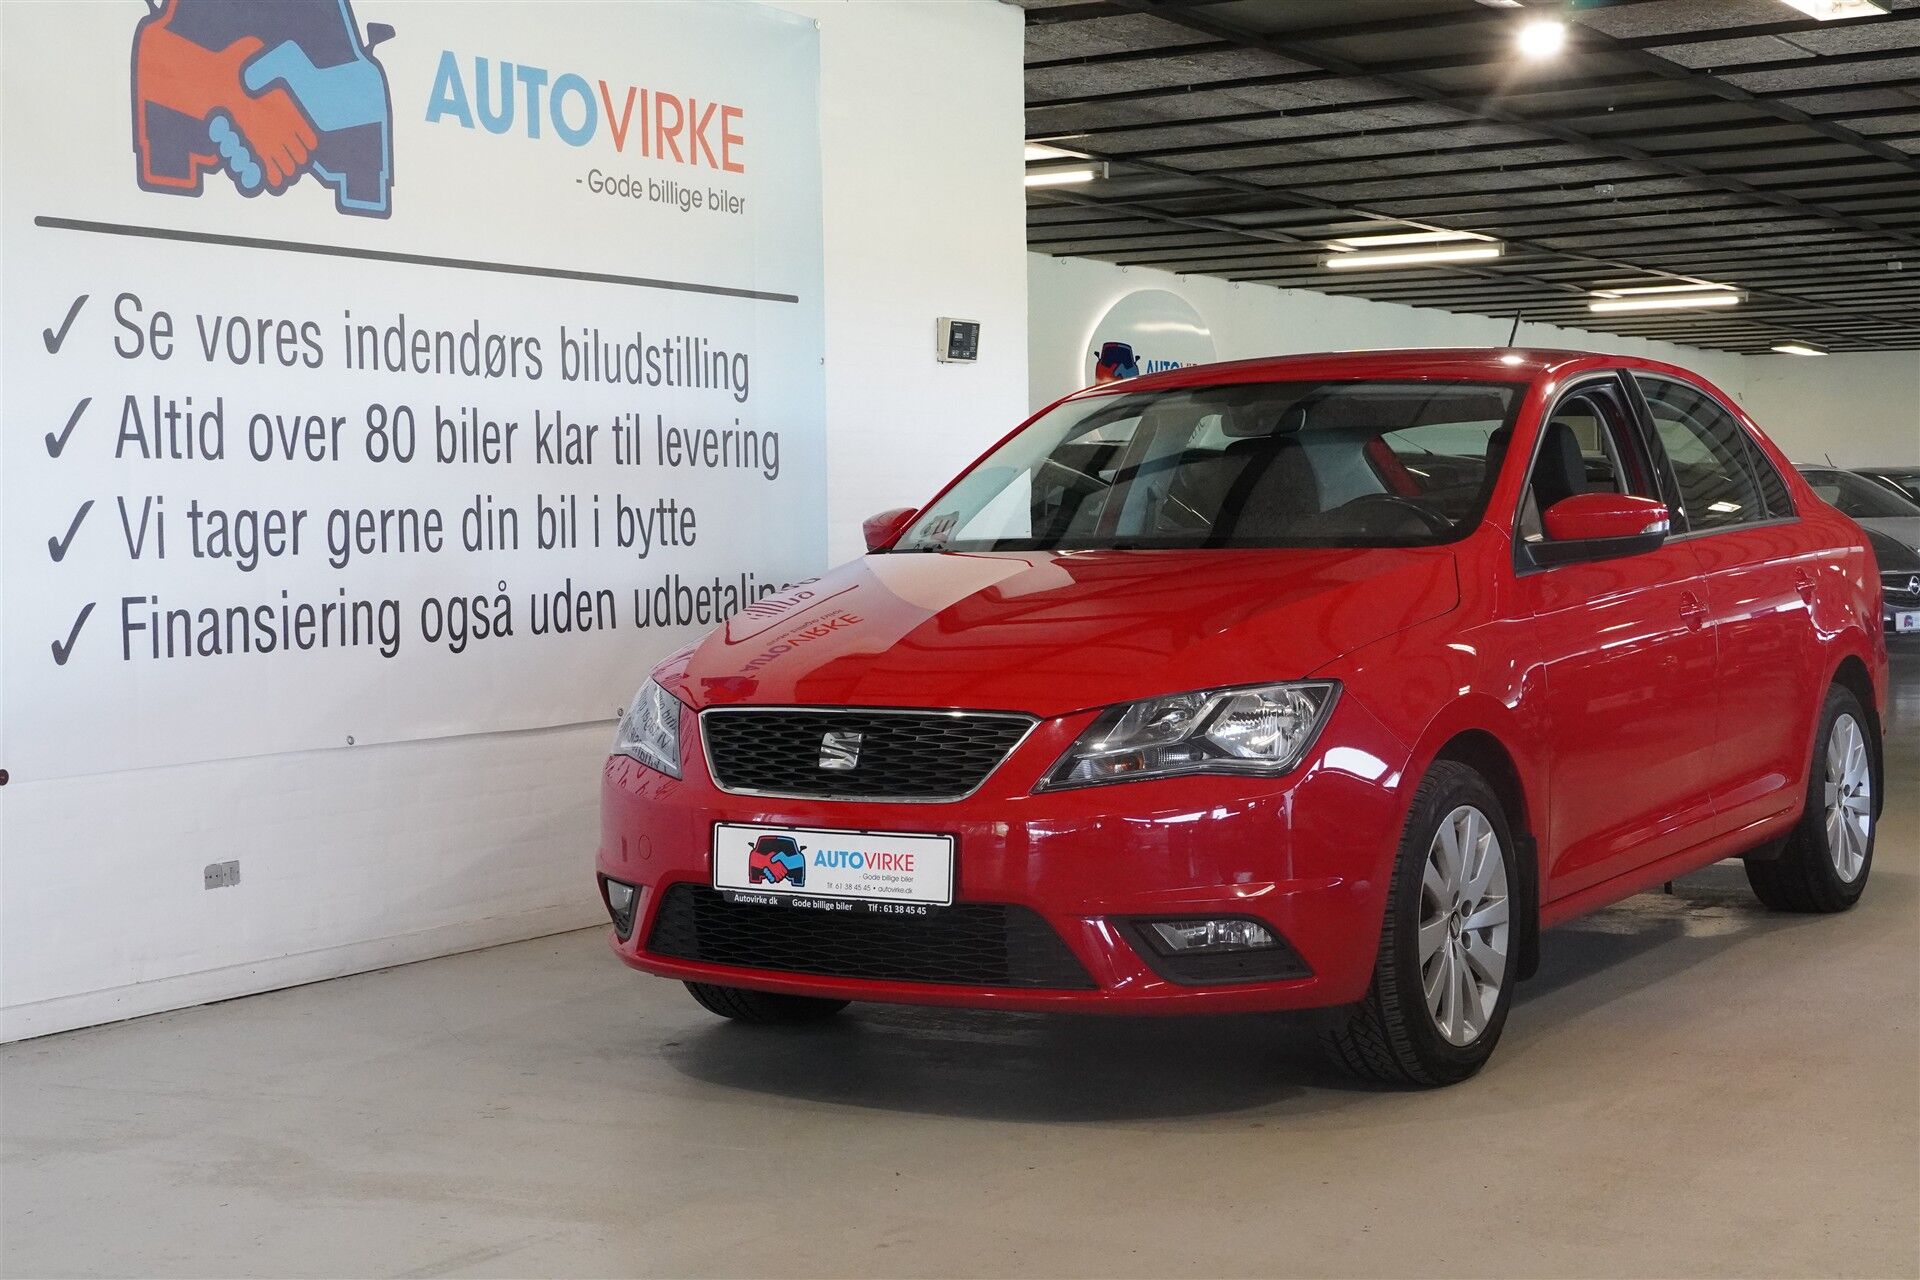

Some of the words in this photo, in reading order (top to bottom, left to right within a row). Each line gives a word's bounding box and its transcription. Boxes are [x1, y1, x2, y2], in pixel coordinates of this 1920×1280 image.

[425, 50, 745, 174] AUTOVIRKE
[588, 168, 643, 200] Gode
[648, 177, 703, 213] billige
[708, 187, 746, 215] biler
[113, 292, 174, 361] Se
[196, 314, 324, 369] vores
[344, 309, 543, 381] indendørs
[560, 325, 749, 404] biludstilling
[114, 394, 225, 461] Altid
[248, 413, 347, 463] over
[365, 403, 416, 464] 80
[435, 405, 519, 465] biler
[534, 409, 599, 466] klar
[611, 413, 642, 466] til
[656, 414, 780, 481] levering
[116, 495, 165, 560] Vi
[186, 499, 308, 573] tager
[327, 508, 444, 570] gerne
[461, 493, 519, 553] din
[537, 493, 577, 551] bil
[593, 494, 600, 548] i
[616, 493, 697, 560] bytte
[121, 587, 401, 661] Finansiering
[420, 579, 514, 655] også
[530, 577, 617, 636] uden
[814, 849, 914, 872] AUTOVIRKE
[862, 873, 880, 881] Gode
[734, 894, 767, 904] Autovirke
[792, 899, 812, 908] Gode
[812, 900, 835, 911] billige
[835, 902, 853, 911] biler
[867, 903, 878, 912] Tlf
[883, 904, 893, 913] 61
[894, 905, 905, 914] 38
[905, 906, 915, 914] 45
[916, 906, 927, 915] 45
